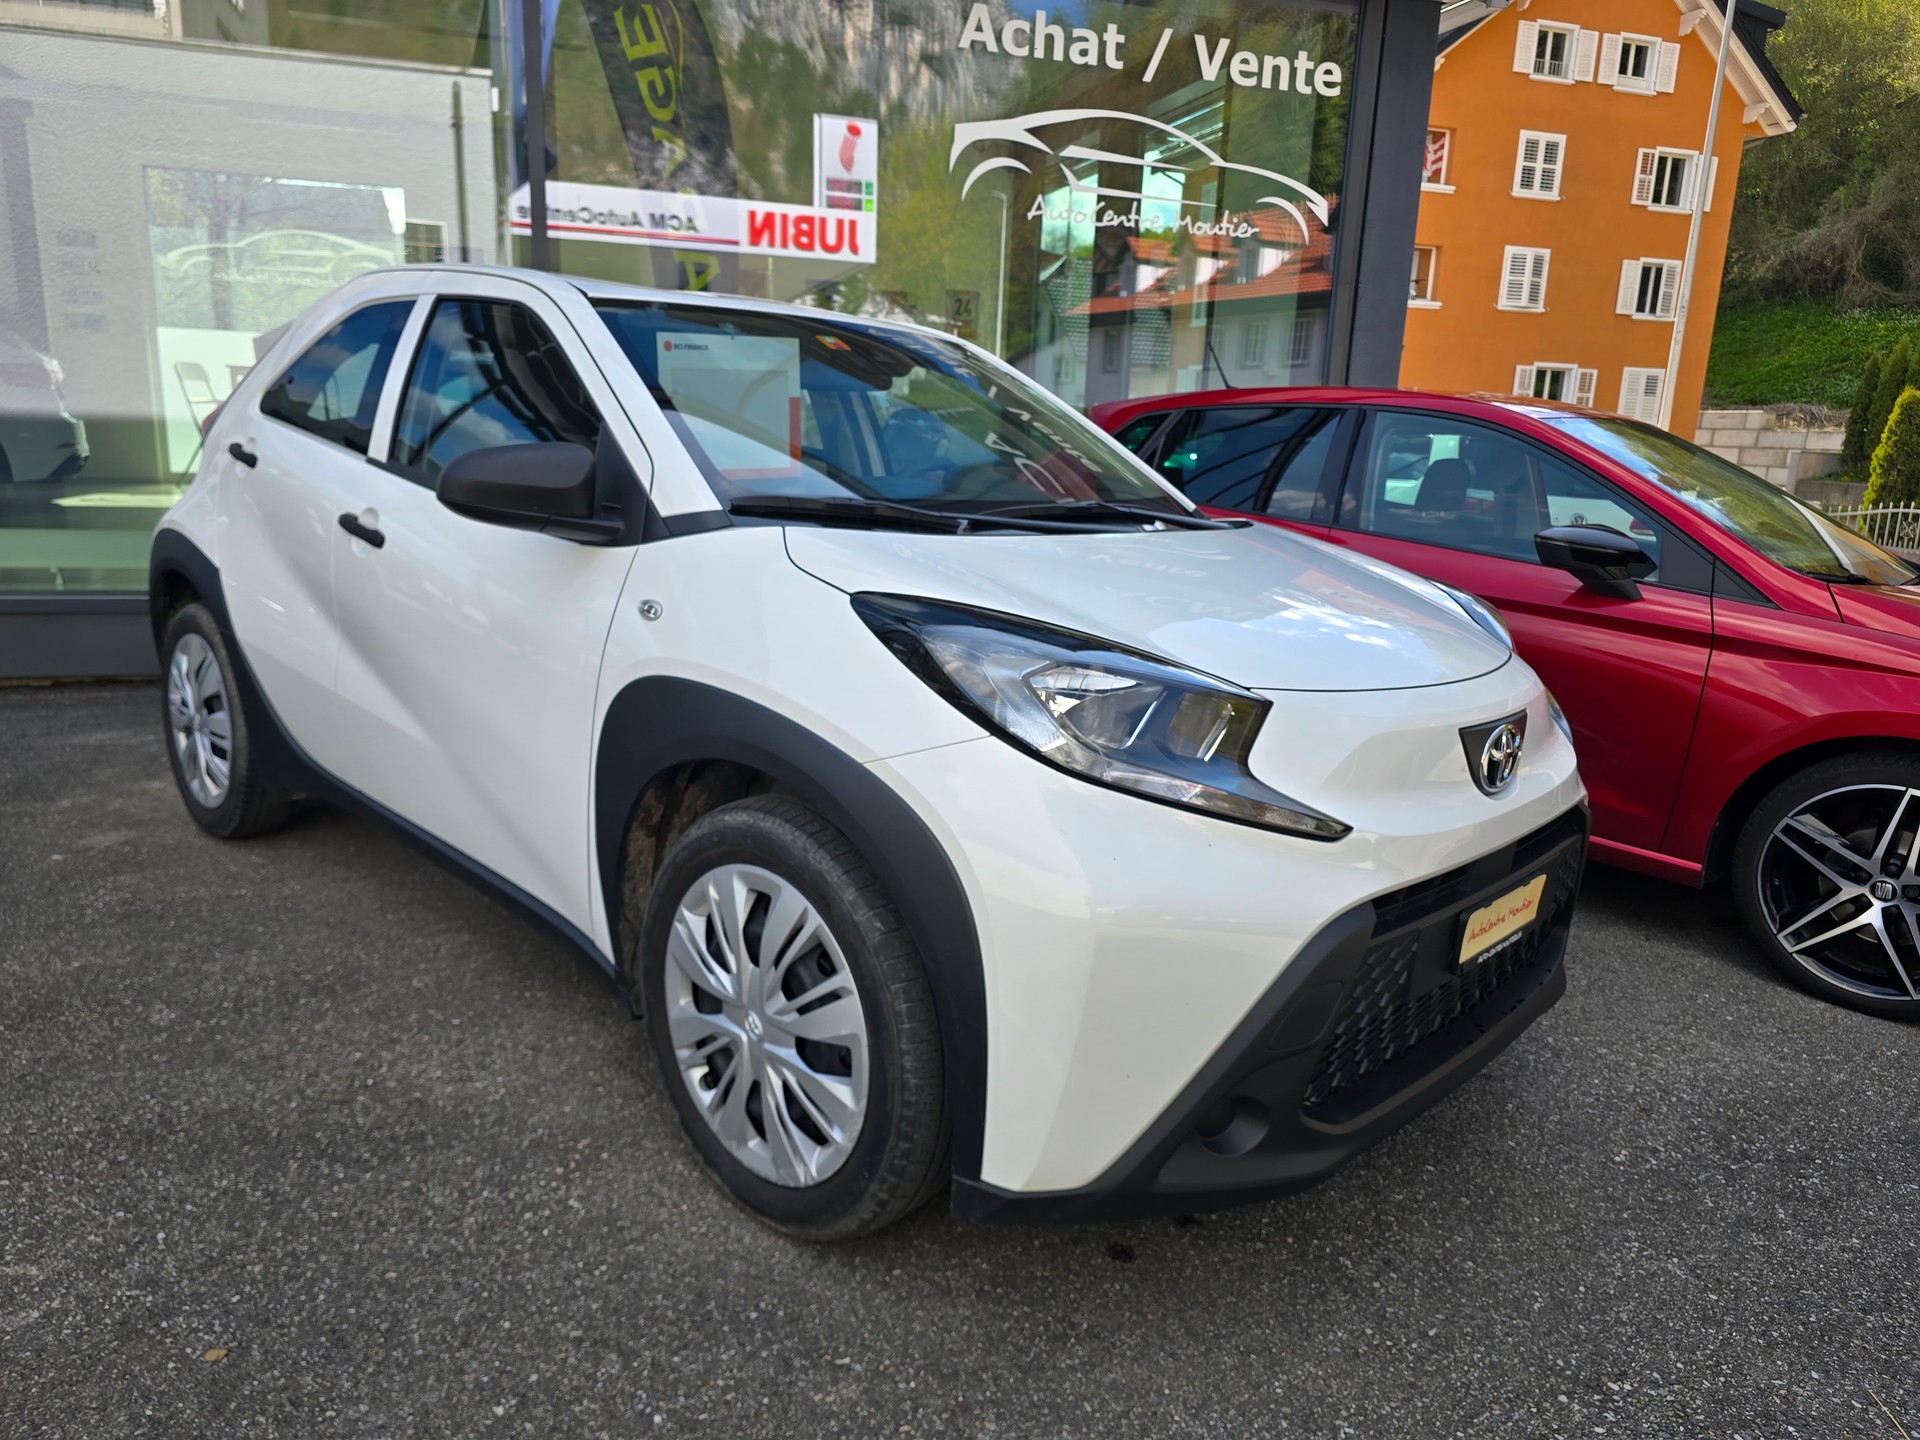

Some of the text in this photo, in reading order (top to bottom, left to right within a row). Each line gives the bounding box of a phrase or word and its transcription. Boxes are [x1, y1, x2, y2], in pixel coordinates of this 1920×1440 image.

[958, 3, 1342, 97] Achat / Vente
[1172, 210, 1259, 239] Moutier
